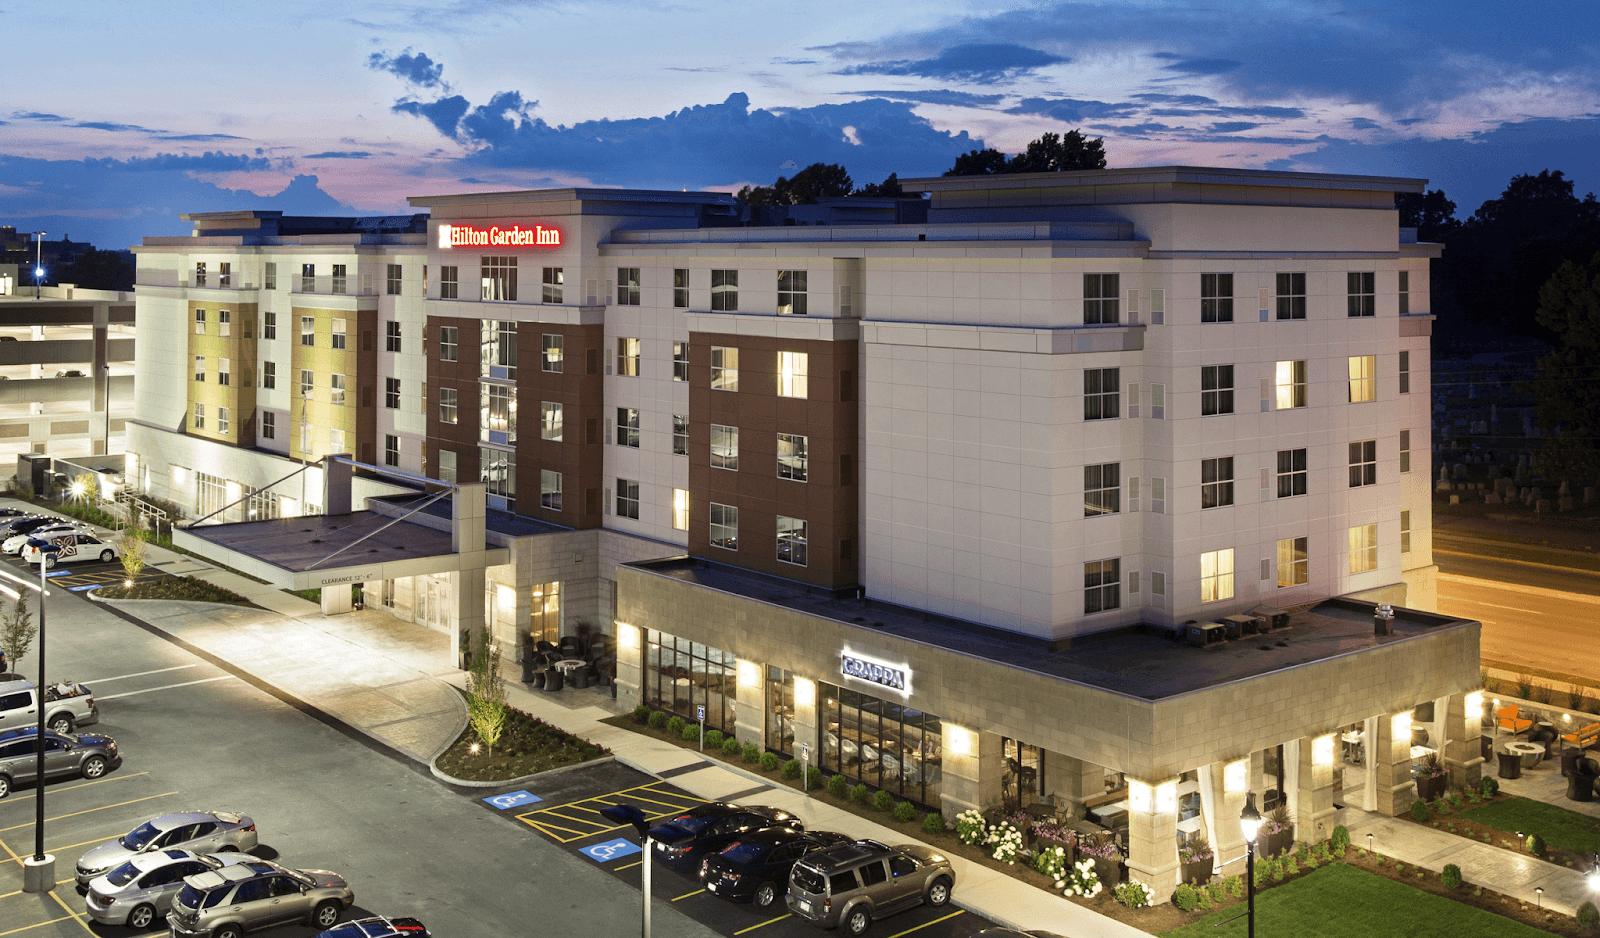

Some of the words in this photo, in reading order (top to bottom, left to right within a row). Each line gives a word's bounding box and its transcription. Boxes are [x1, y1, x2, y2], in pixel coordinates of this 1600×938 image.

[451, 226, 489, 246] Hilton
[489, 225, 535, 246] Garden
[535, 225, 561, 245] Inn
[321, 576, 353, 585] CLEARANCE
[843, 657, 904, 689] GRAPPA
